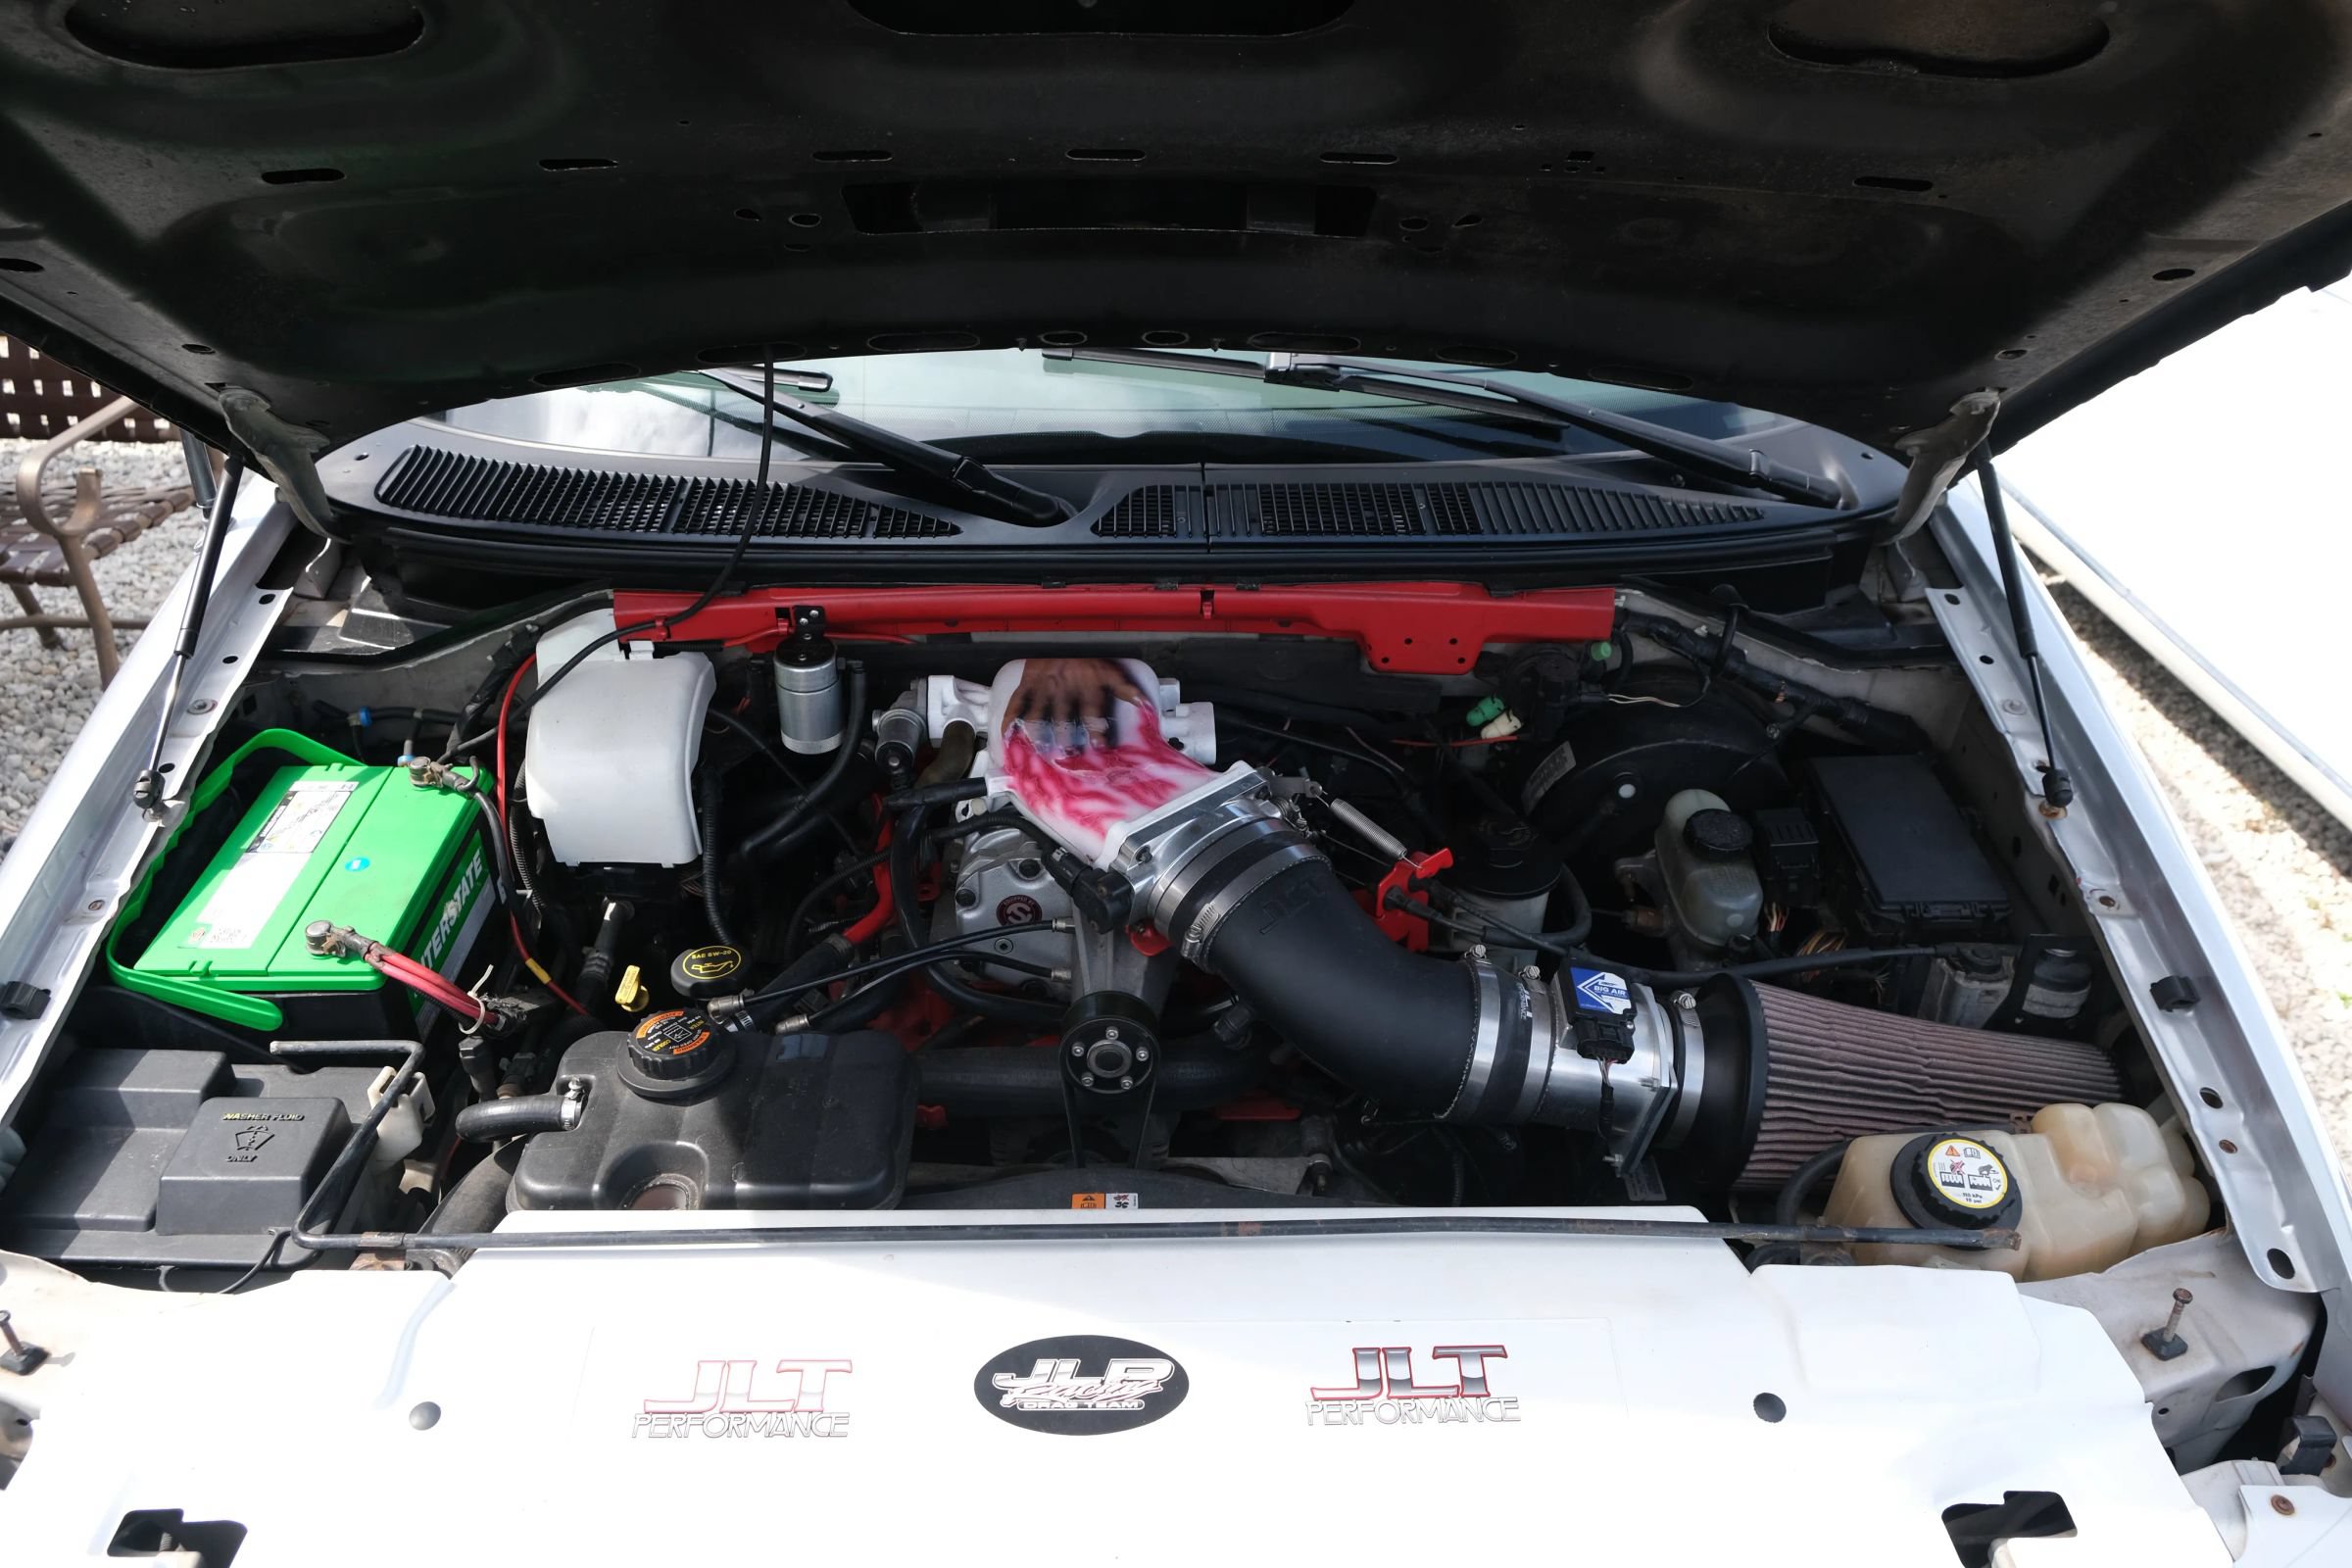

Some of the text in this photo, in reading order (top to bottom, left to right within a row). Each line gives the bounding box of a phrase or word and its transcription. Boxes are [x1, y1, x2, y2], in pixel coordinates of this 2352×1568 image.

[419, 847, 483, 971] TERSTATE
[1611, 987, 1627, 996] AIR
[222, 1112, 271, 1121] WASHER
[643, 1358, 854, 1414] JLT
[992, 1358, 1174, 1390] JLP
[1309, 1345, 1508, 1400] JLT
[1000, 1377, 1163, 1407] Racing
[1022, 1400, 1139, 1410] DRAG TEAM
[631, 1411, 851, 1439] PERFORMANCE
[1304, 1395, 1522, 1427] PERFORMANCE
